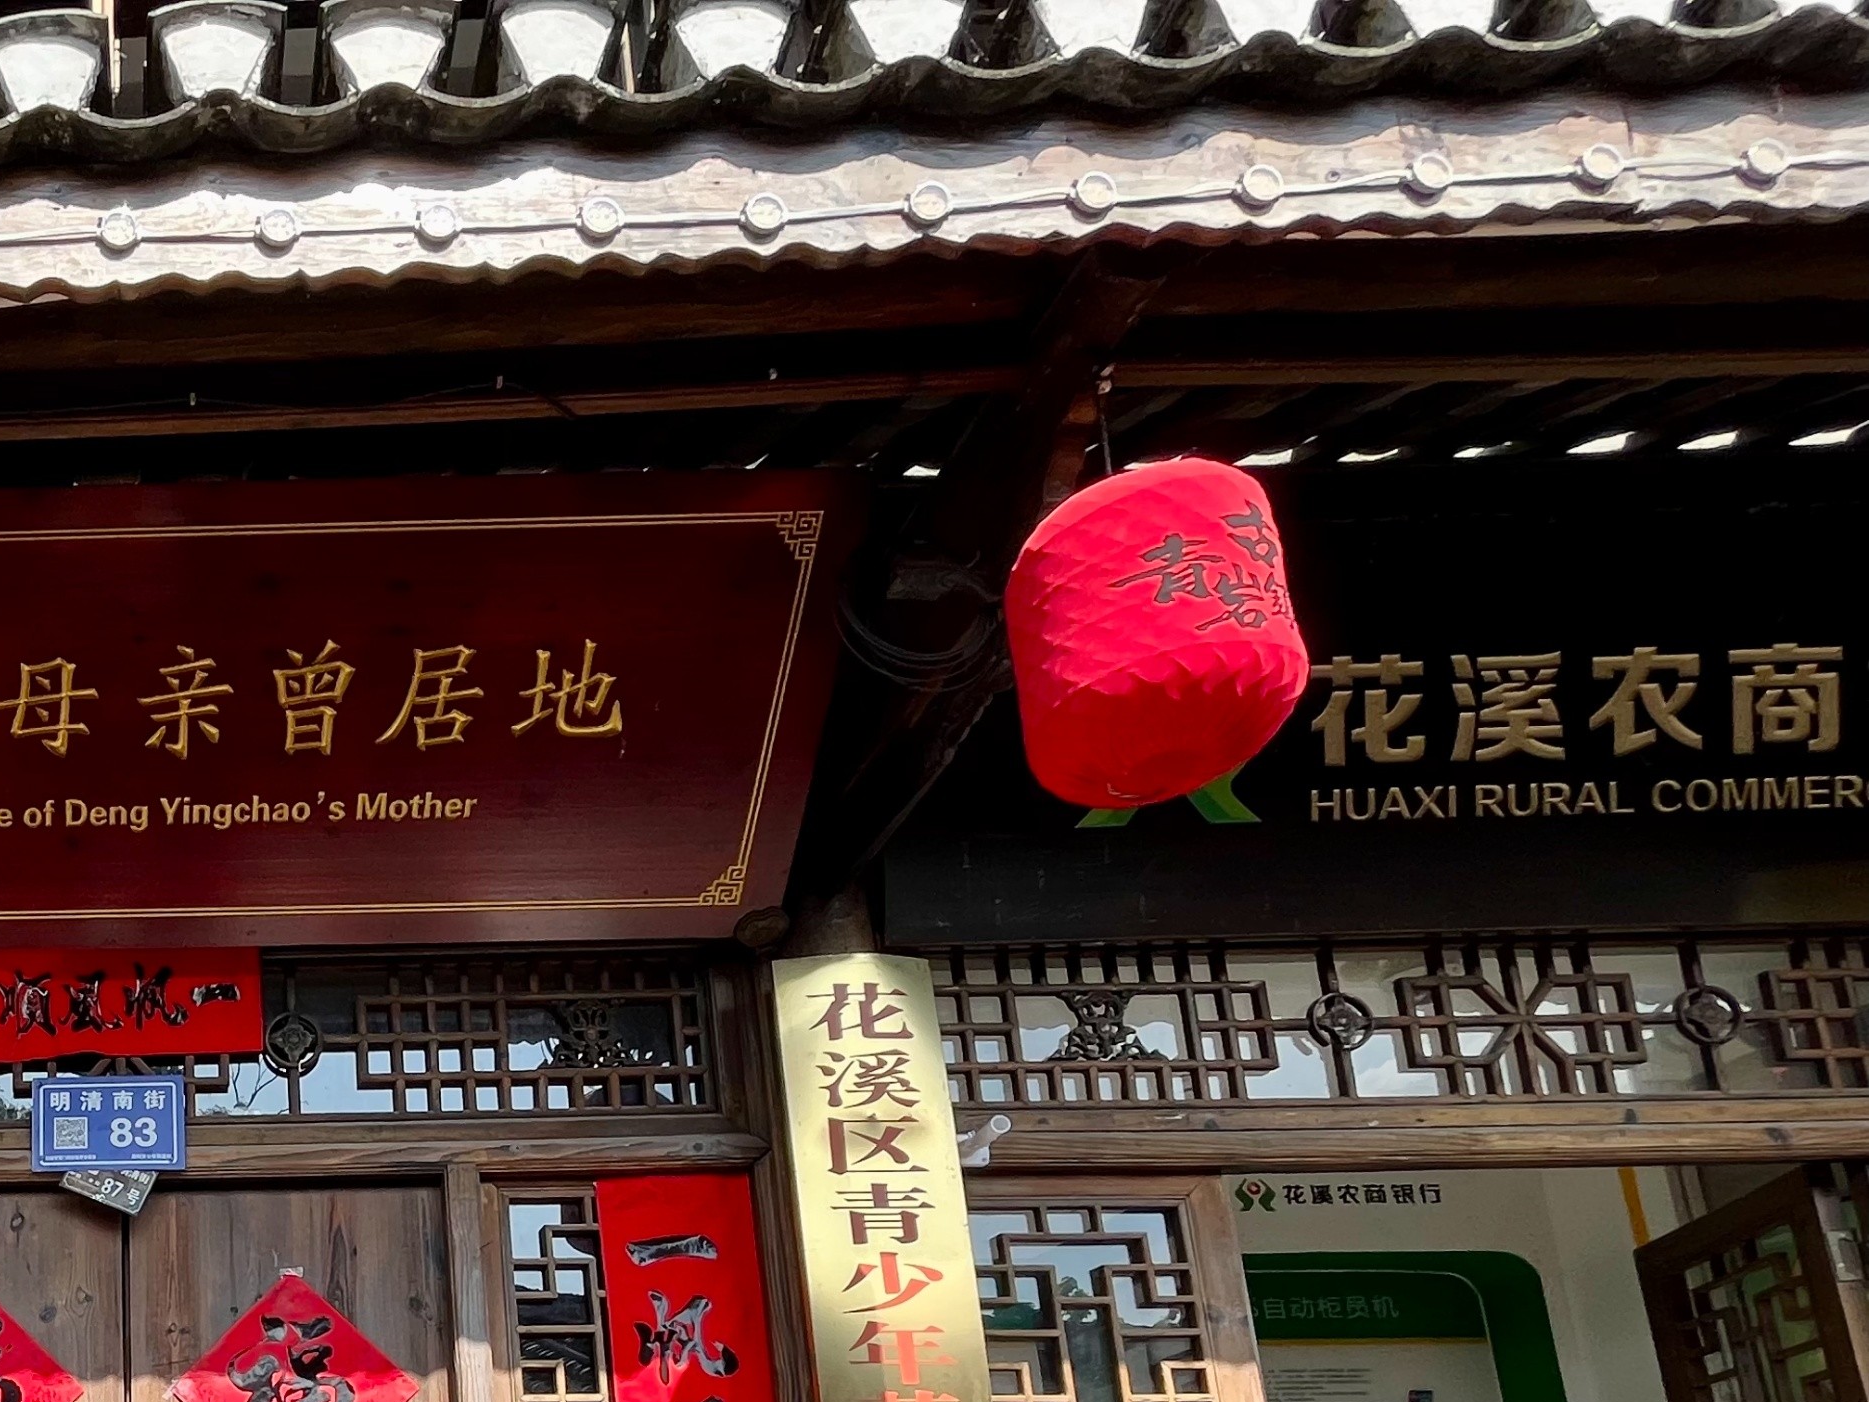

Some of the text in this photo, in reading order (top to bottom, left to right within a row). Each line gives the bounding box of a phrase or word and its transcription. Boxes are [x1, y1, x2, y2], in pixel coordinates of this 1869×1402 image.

[1310, 642, 1844, 767] 花溪农商
[23, 800, 55, 828] of
[65, 799, 149, 833] Deng
[356, 791, 478, 822] Mother
[1310, 774, 1869, 822] HUAXI RURAL COMMER
[49, 1089, 166, 1113] 明清南街
[109, 1116, 158, 1149] 83
[1281, 1184, 1442, 1206] 花溪农商银行
